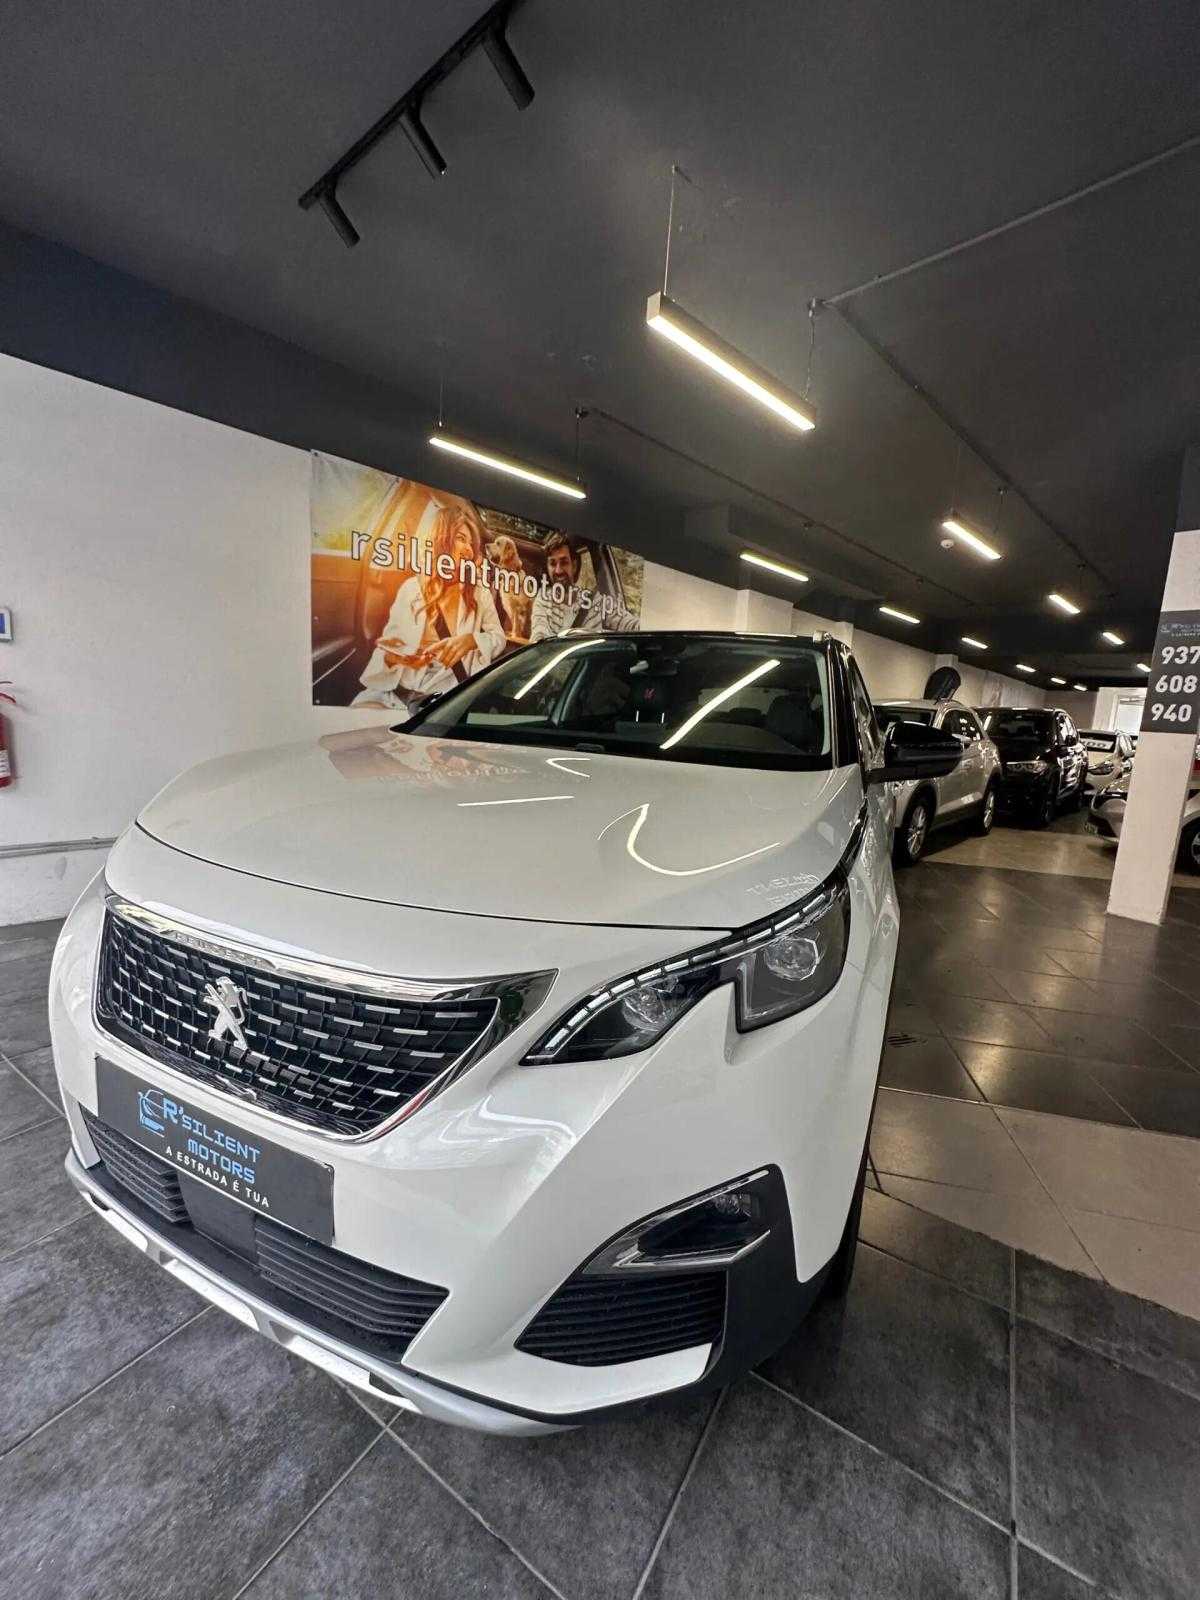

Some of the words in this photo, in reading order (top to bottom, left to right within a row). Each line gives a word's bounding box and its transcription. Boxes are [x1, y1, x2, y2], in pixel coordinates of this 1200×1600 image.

[1161, 645, 1200, 665] 937
[1155, 674, 1198, 694] 608
[1151, 702, 1193, 722] 940
[163, 1097, 261, 1163] R'SILIENT
[165, 1145, 173, 1157] A
[176, 1151, 228, 1187] ESTRADA
[232, 1179, 240, 1193] É
[245, 1187, 270, 1208] TUA
[187, 1138, 256, 1184] MOTORS
